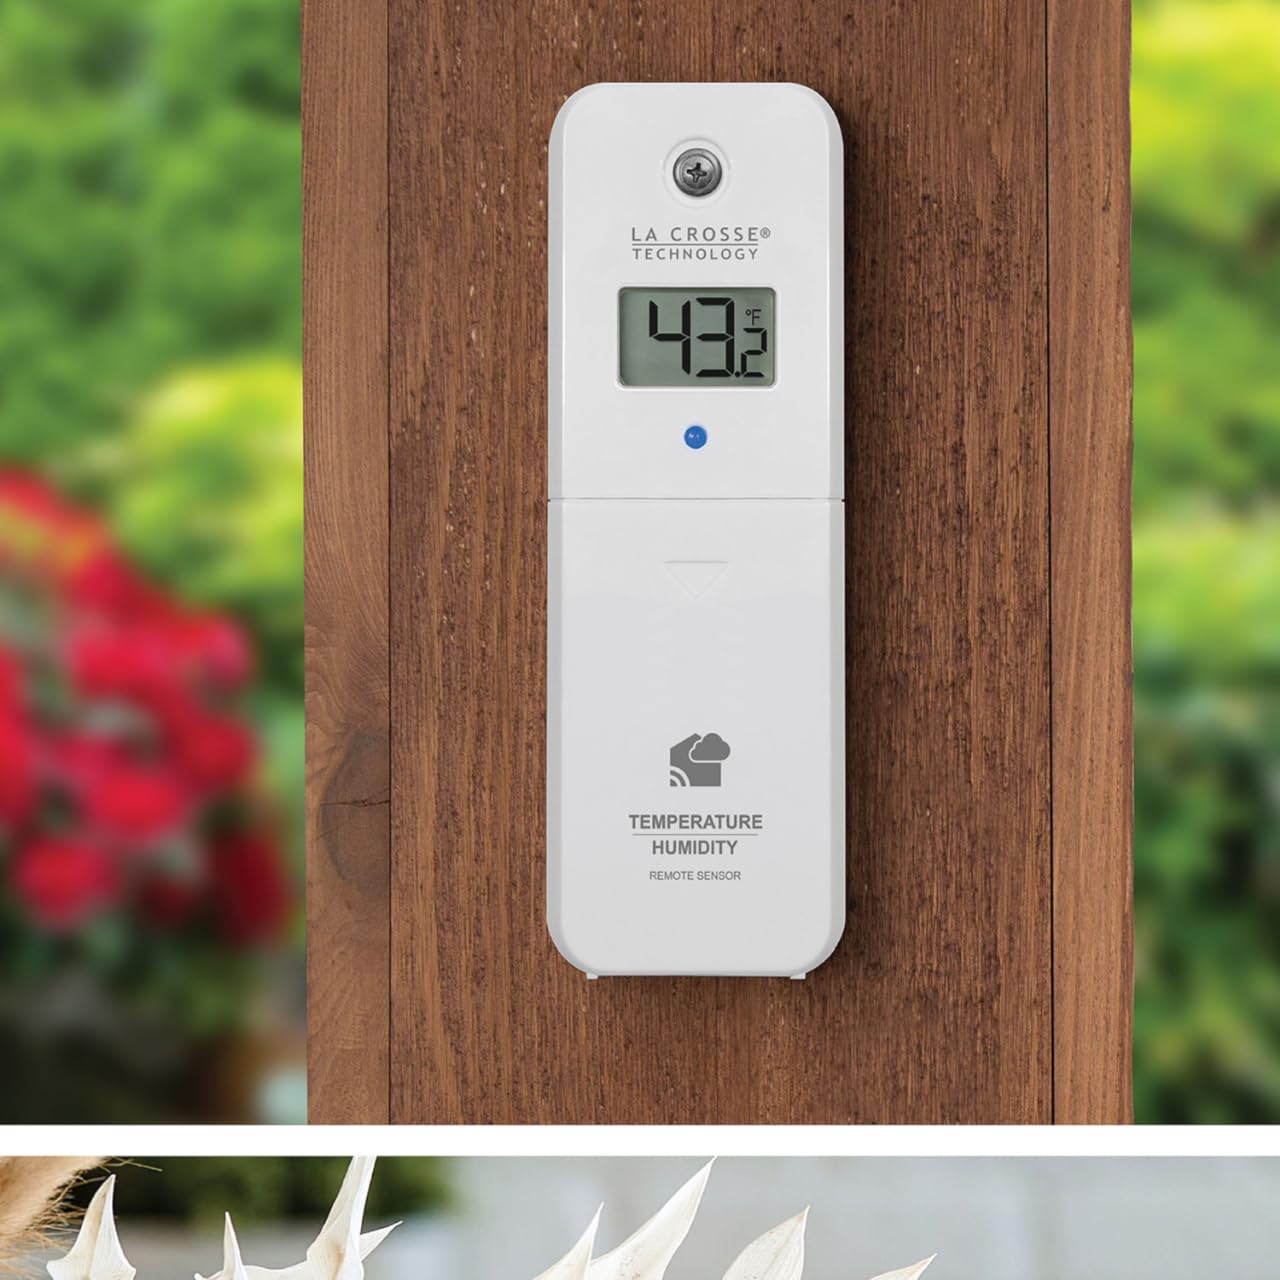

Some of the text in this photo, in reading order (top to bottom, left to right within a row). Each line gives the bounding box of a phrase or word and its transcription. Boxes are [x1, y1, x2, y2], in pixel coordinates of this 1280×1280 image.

[631, 227, 657, 242] LA
[632, 248, 758, 260] TECHNOLOGY
[629, 814, 763, 829] TEMPERATURE
[652, 840, 738, 855] HUMIDITY
[649, 871, 741, 880] REMOTE SENSOR
